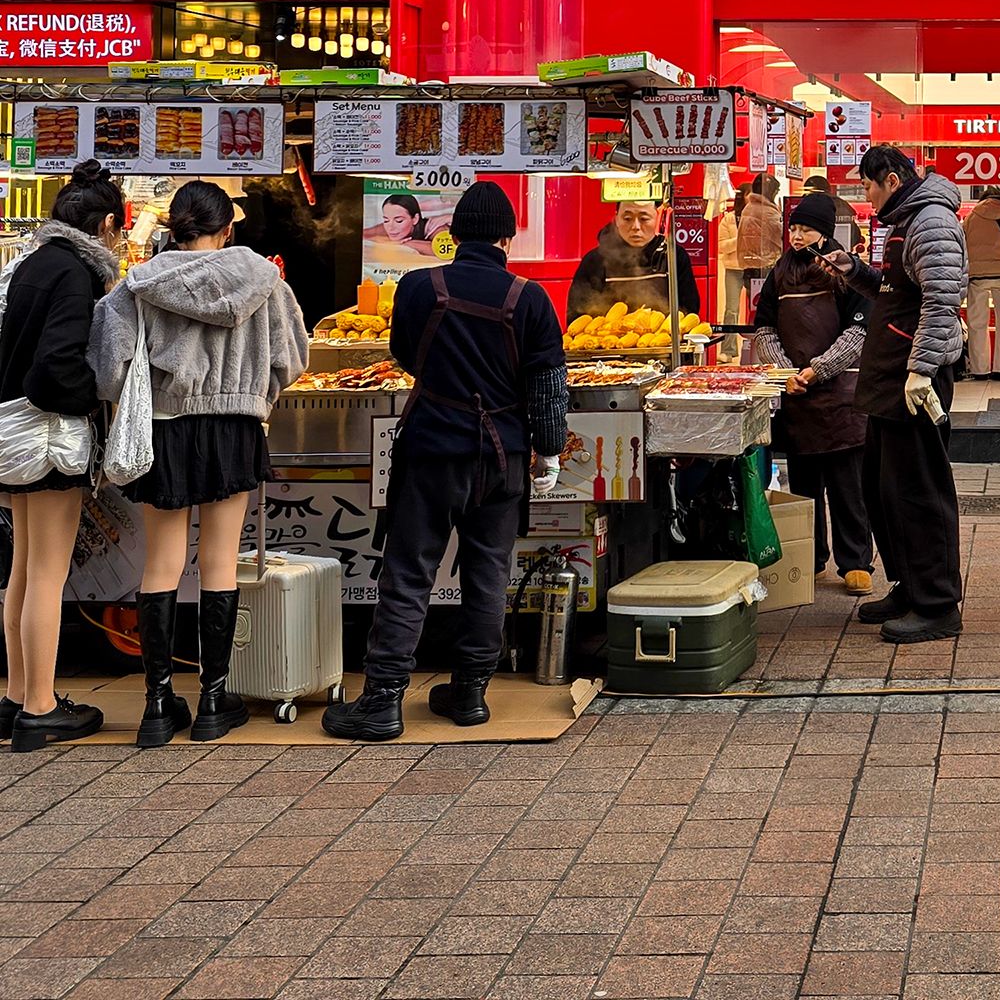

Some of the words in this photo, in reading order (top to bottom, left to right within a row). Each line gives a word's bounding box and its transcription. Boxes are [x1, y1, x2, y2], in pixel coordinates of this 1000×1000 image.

[668, 94, 690, 102] Beef
[691, 94, 718, 102] Sticks
[332, 102, 350, 111] Set
[351, 102, 381, 111] Menu
[640, 145, 688, 154] Barecue
[690, 145, 725, 154] 10,000
[415, 171, 461, 187] 5.000
[384, 181, 408, 189] HAN
[675, 229, 704, 244] 0%
[439, 244, 453, 254] 3F
[341, 587, 378, 600] 가맹점
